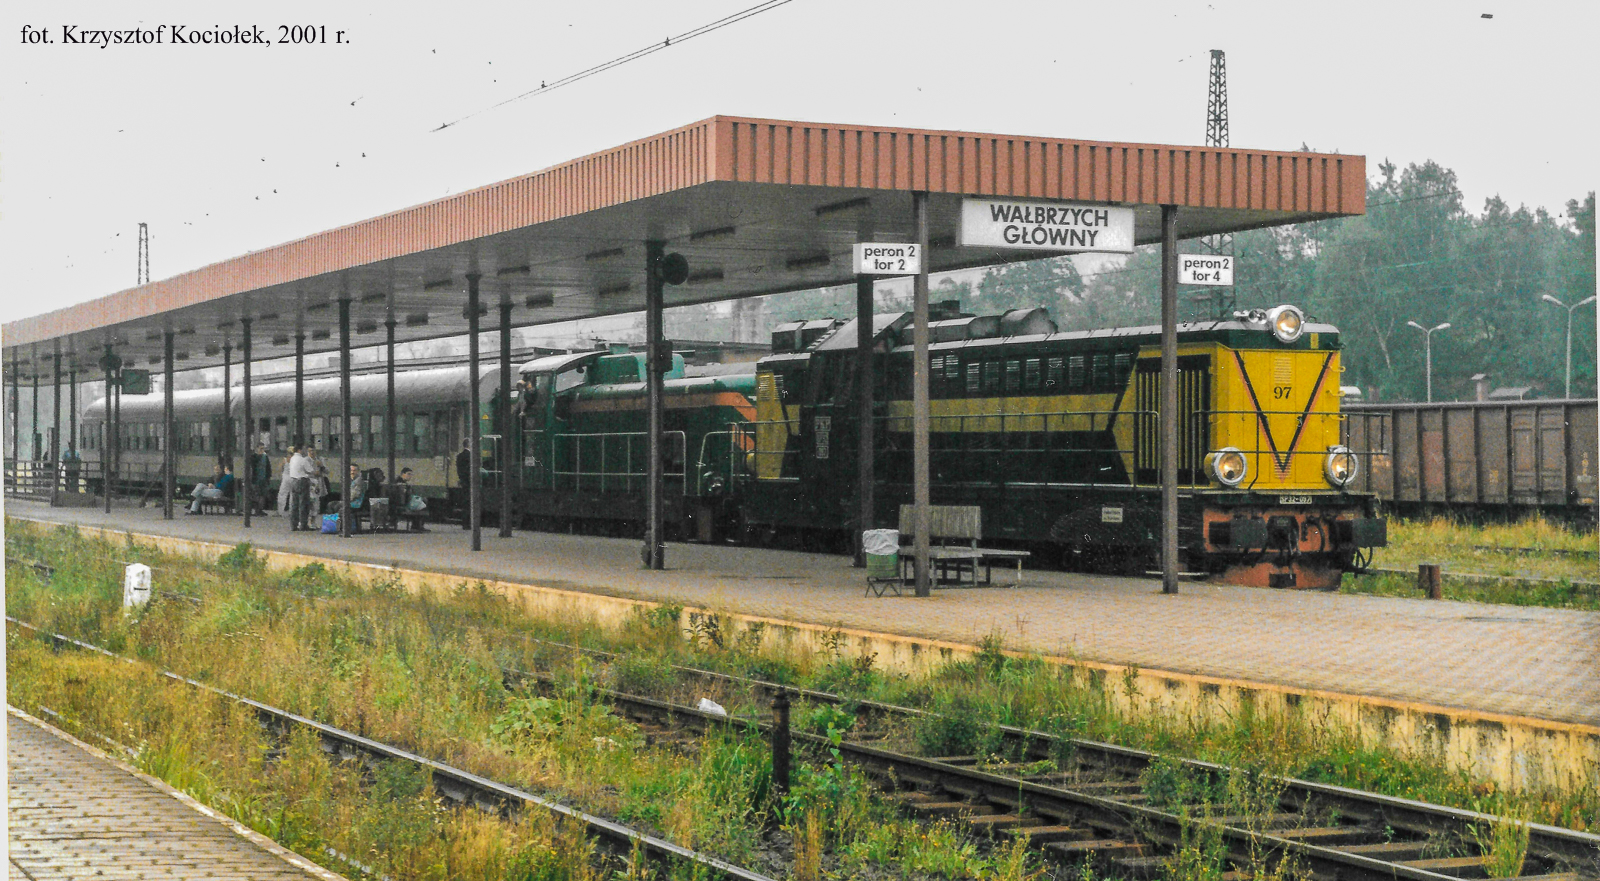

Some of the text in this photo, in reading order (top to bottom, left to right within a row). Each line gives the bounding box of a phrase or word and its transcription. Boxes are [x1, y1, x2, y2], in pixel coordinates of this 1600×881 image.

[990, 204, 1109, 228] WAŁBRZYCH
[1003, 222, 1099, 247] GŁÓWNY
[864, 245, 915, 260] peron 2
[874, 258, 905, 271] tor 2
[1184, 258, 1229, 271] peron 2
[1192, 270, 1221, 282] tor 4
[1273, 386, 1292, 400] 97
